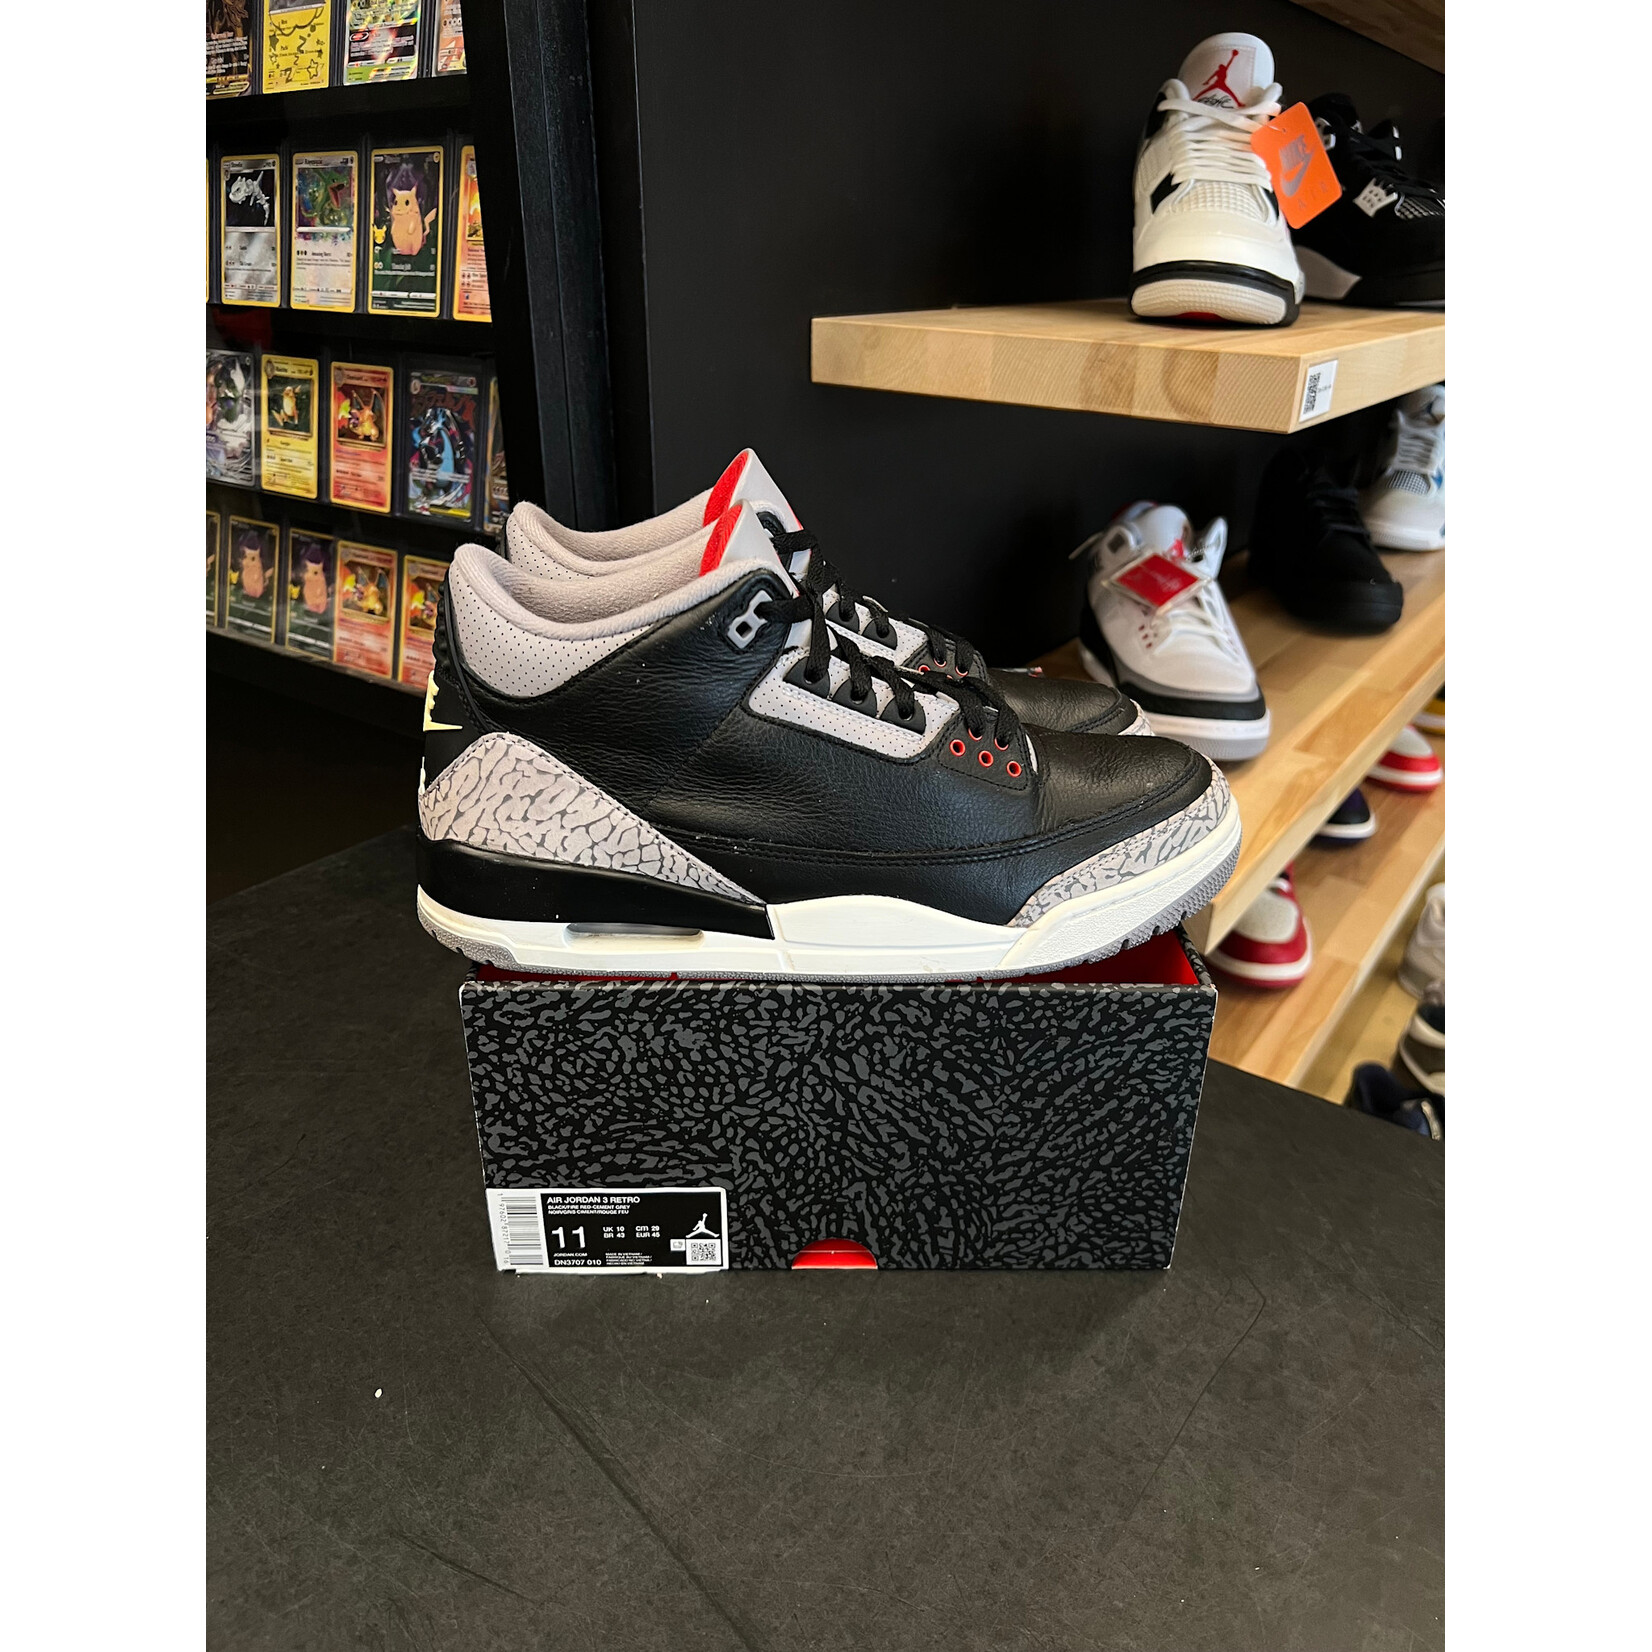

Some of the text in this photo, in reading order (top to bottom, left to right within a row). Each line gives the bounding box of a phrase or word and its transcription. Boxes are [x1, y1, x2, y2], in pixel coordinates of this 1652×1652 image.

[547, 1196, 641, 1204] AIR JORDAN 3 RETRO
[552, 1226, 586, 1249] 11
